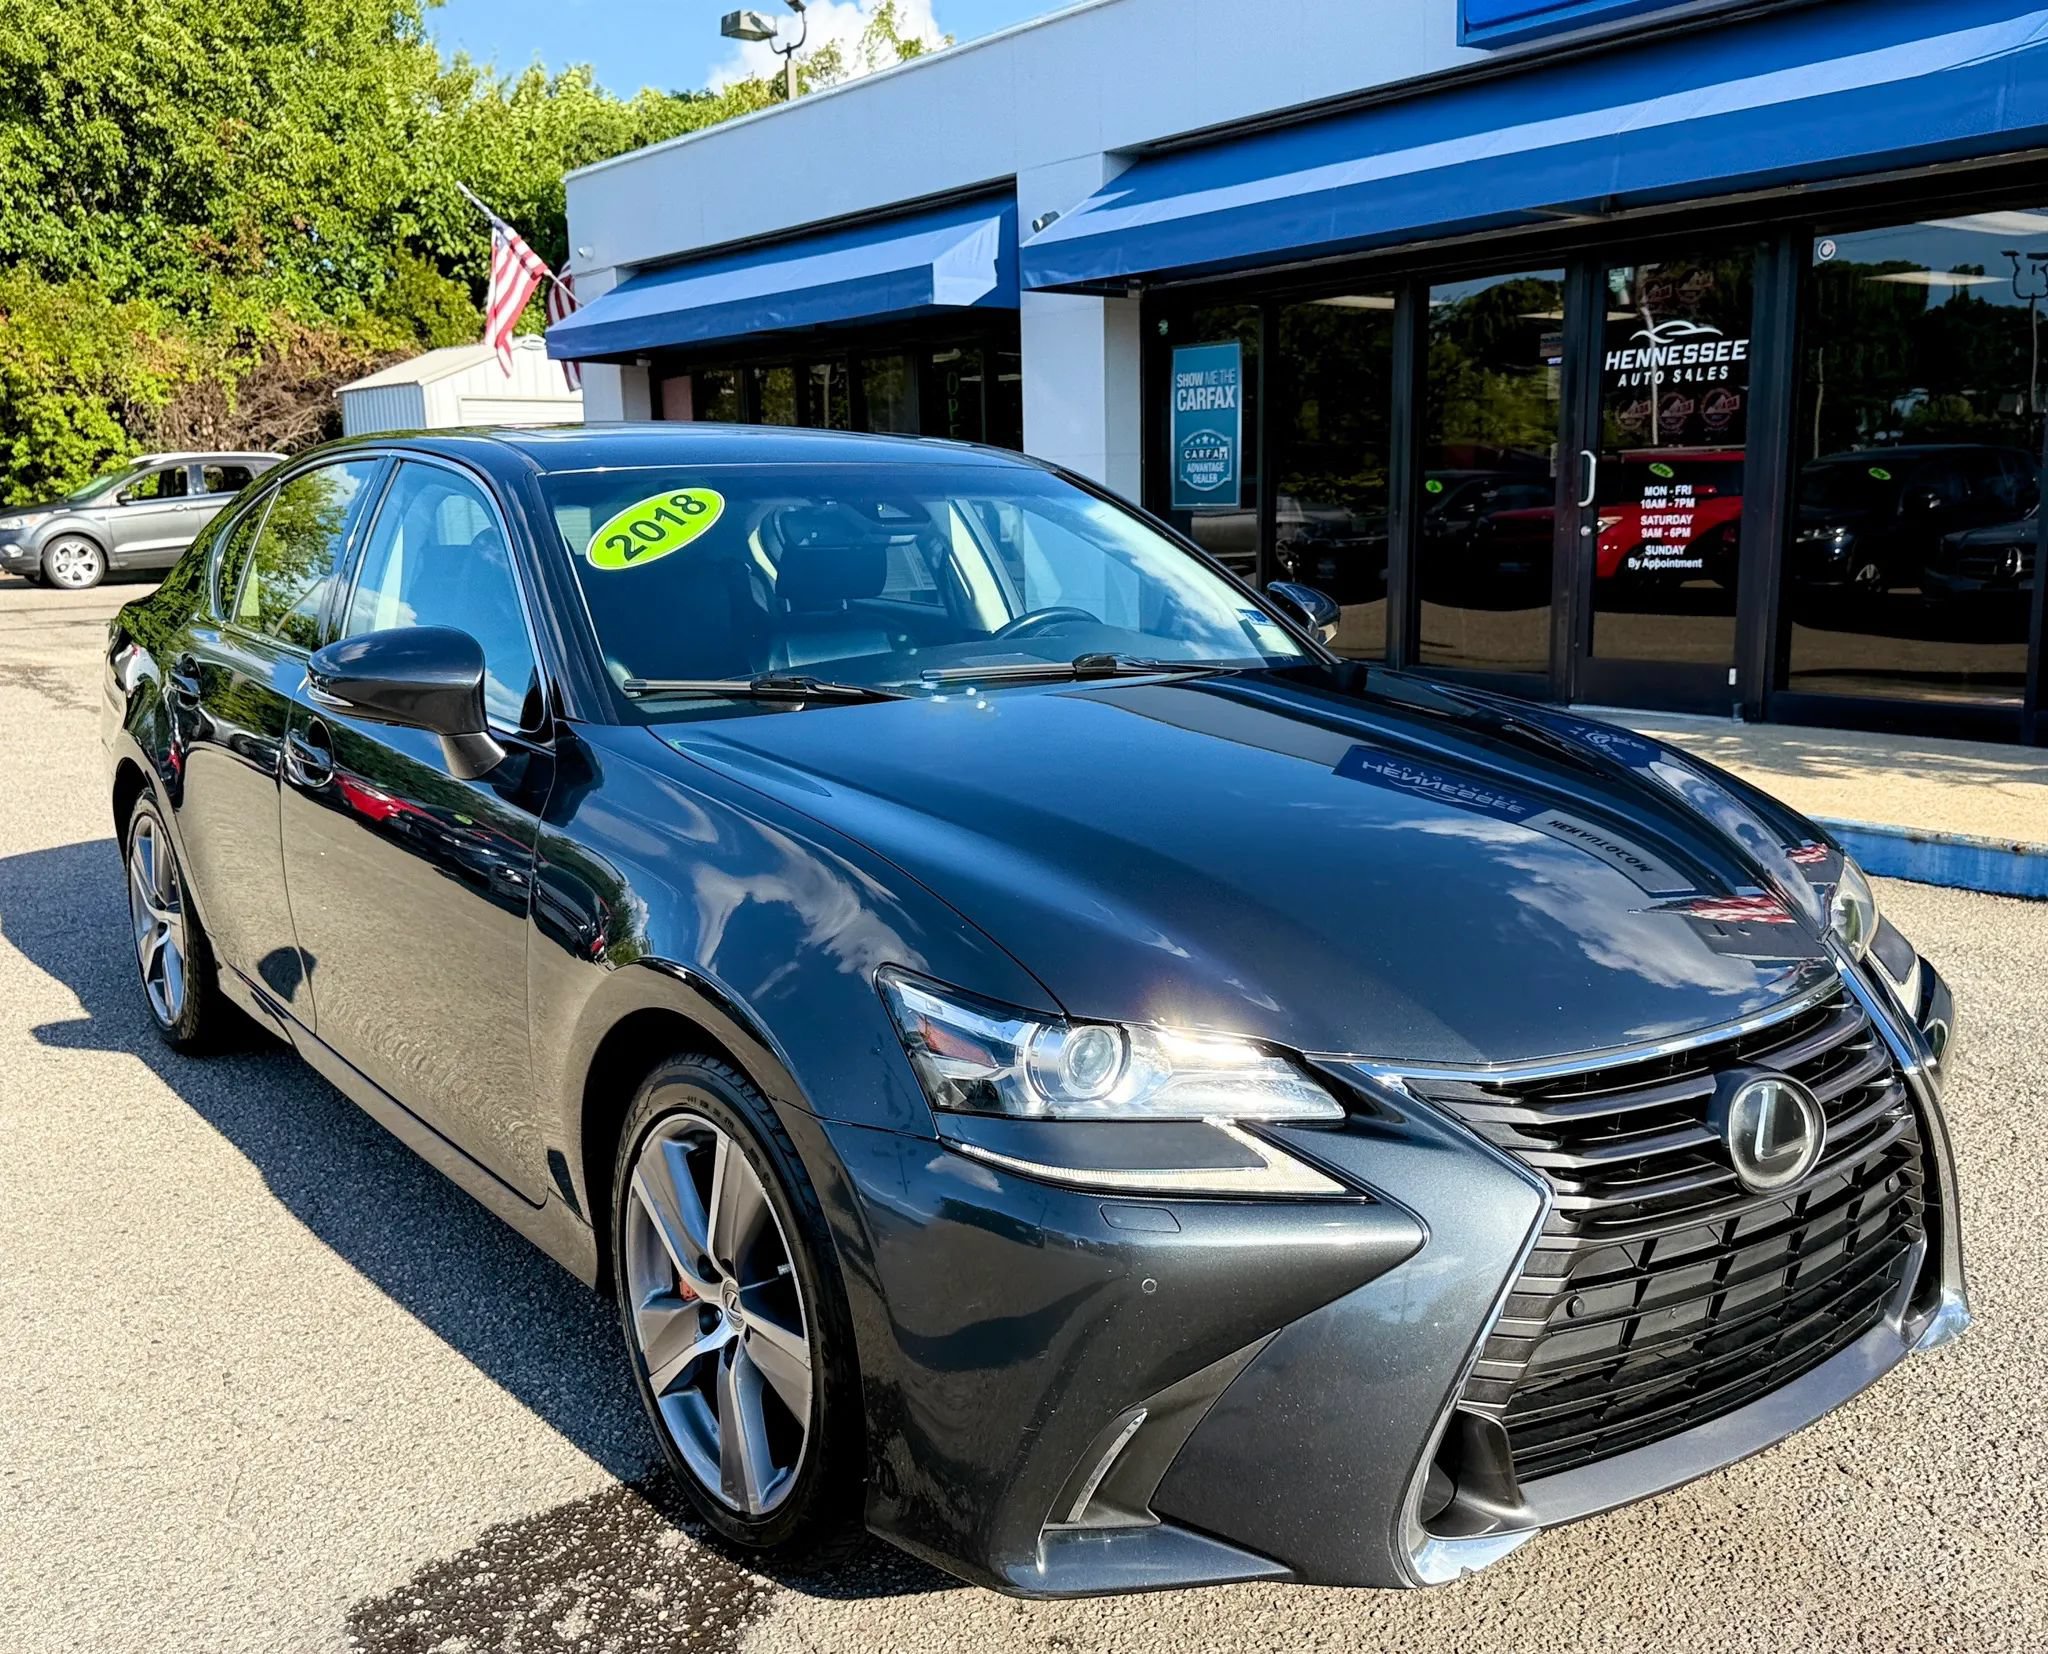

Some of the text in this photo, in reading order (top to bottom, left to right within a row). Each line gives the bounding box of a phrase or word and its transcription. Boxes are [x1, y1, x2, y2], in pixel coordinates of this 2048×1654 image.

[1605, 339, 1749, 371] HENNESSEE
[1176, 368, 1236, 388] SHOW ME THE
[1617, 365, 1729, 387] AUTO SALES
[1176, 385, 1236, 412] CARFAX
[1186, 461, 1225, 473] ADVANTAGE
[1192, 473, 1218, 484] DEALER
[1644, 485, 1668, 497] MON
[1674, 484, 1692, 496] FRI
[1640, 498, 1667, 509] 10AM
[1674, 497, 1695, 509] 7PM
[1640, 514, 1694, 526] SATURDAY
[605, 494, 707, 562] 2018
[1641, 527, 1663, 539] 9AM
[1669, 527, 1691, 538] 6PM
[1645, 545, 1686, 556] SUNDAY
[1628, 557, 1703, 571] By Appointment
